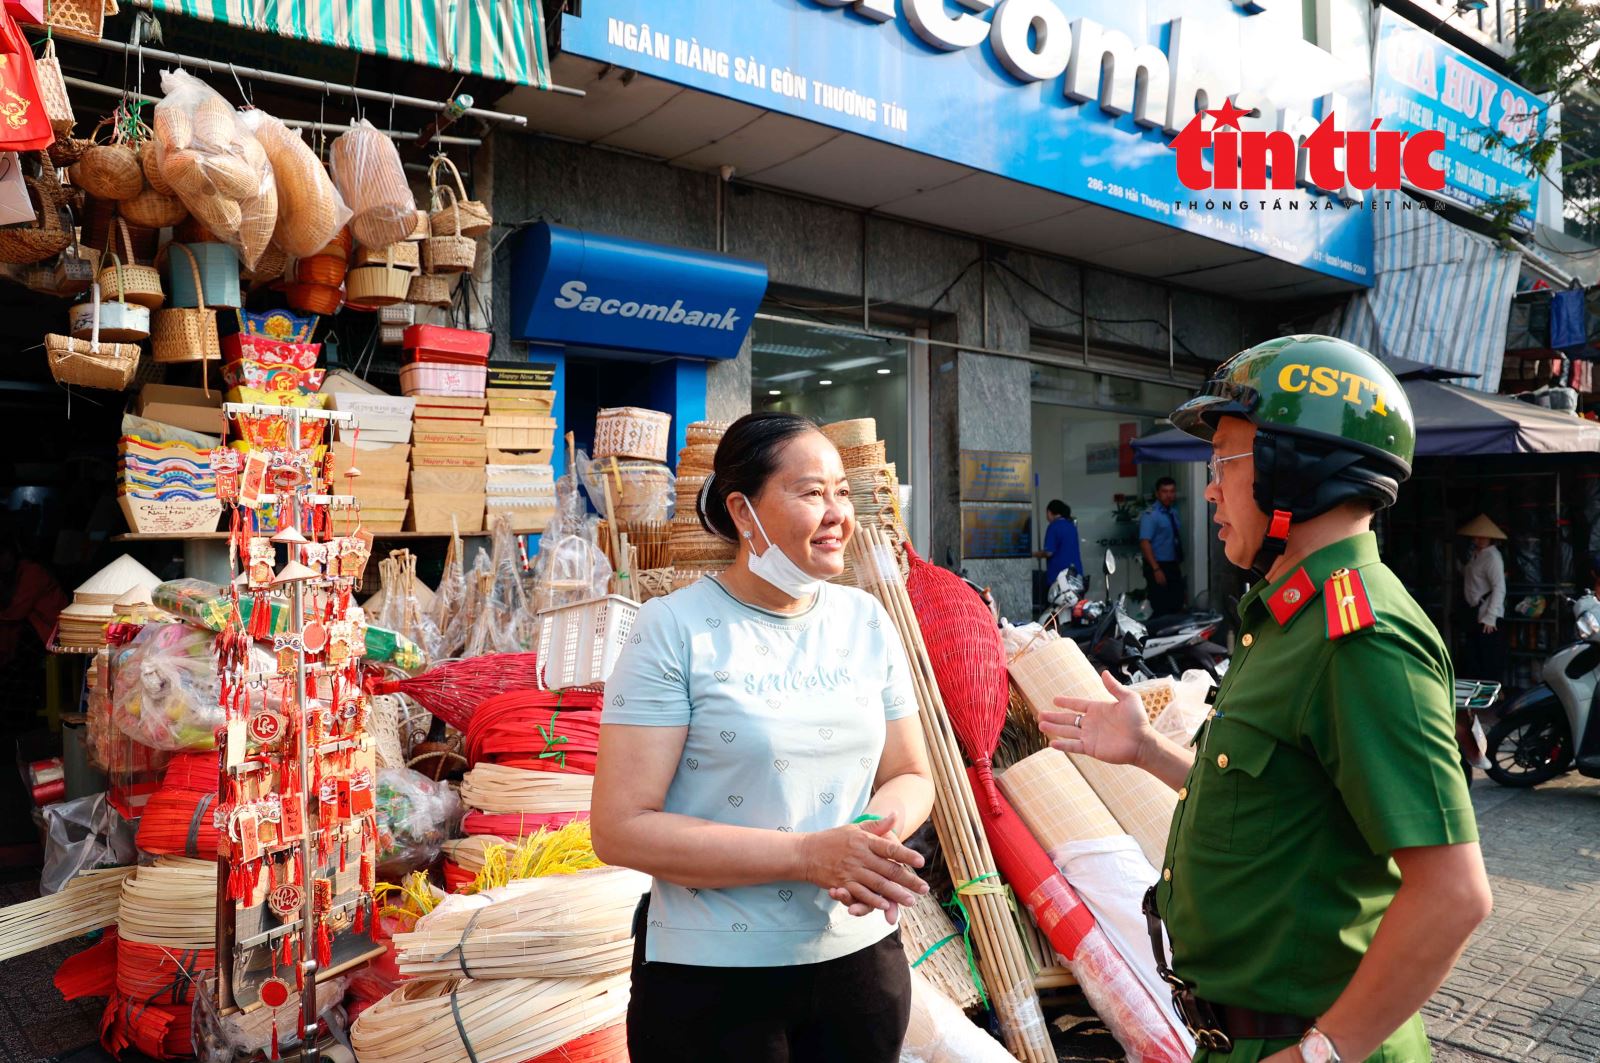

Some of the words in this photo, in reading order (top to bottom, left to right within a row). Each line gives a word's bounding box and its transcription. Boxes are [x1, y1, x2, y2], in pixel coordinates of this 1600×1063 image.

[608, 17, 670, 62] NGÂN
[674, 36, 729, 79] HÀNG
[733, 55, 767, 89] SÀI
[770, 69, 807, 101] GÒN
[812, 79, 877, 123] THƯƠNG
[881, 98, 908, 132] TÍN
[1441, 55, 1498, 127] HUY
[553, 279, 741, 332] Sacombank
[1277, 363, 1390, 417] CSTT
